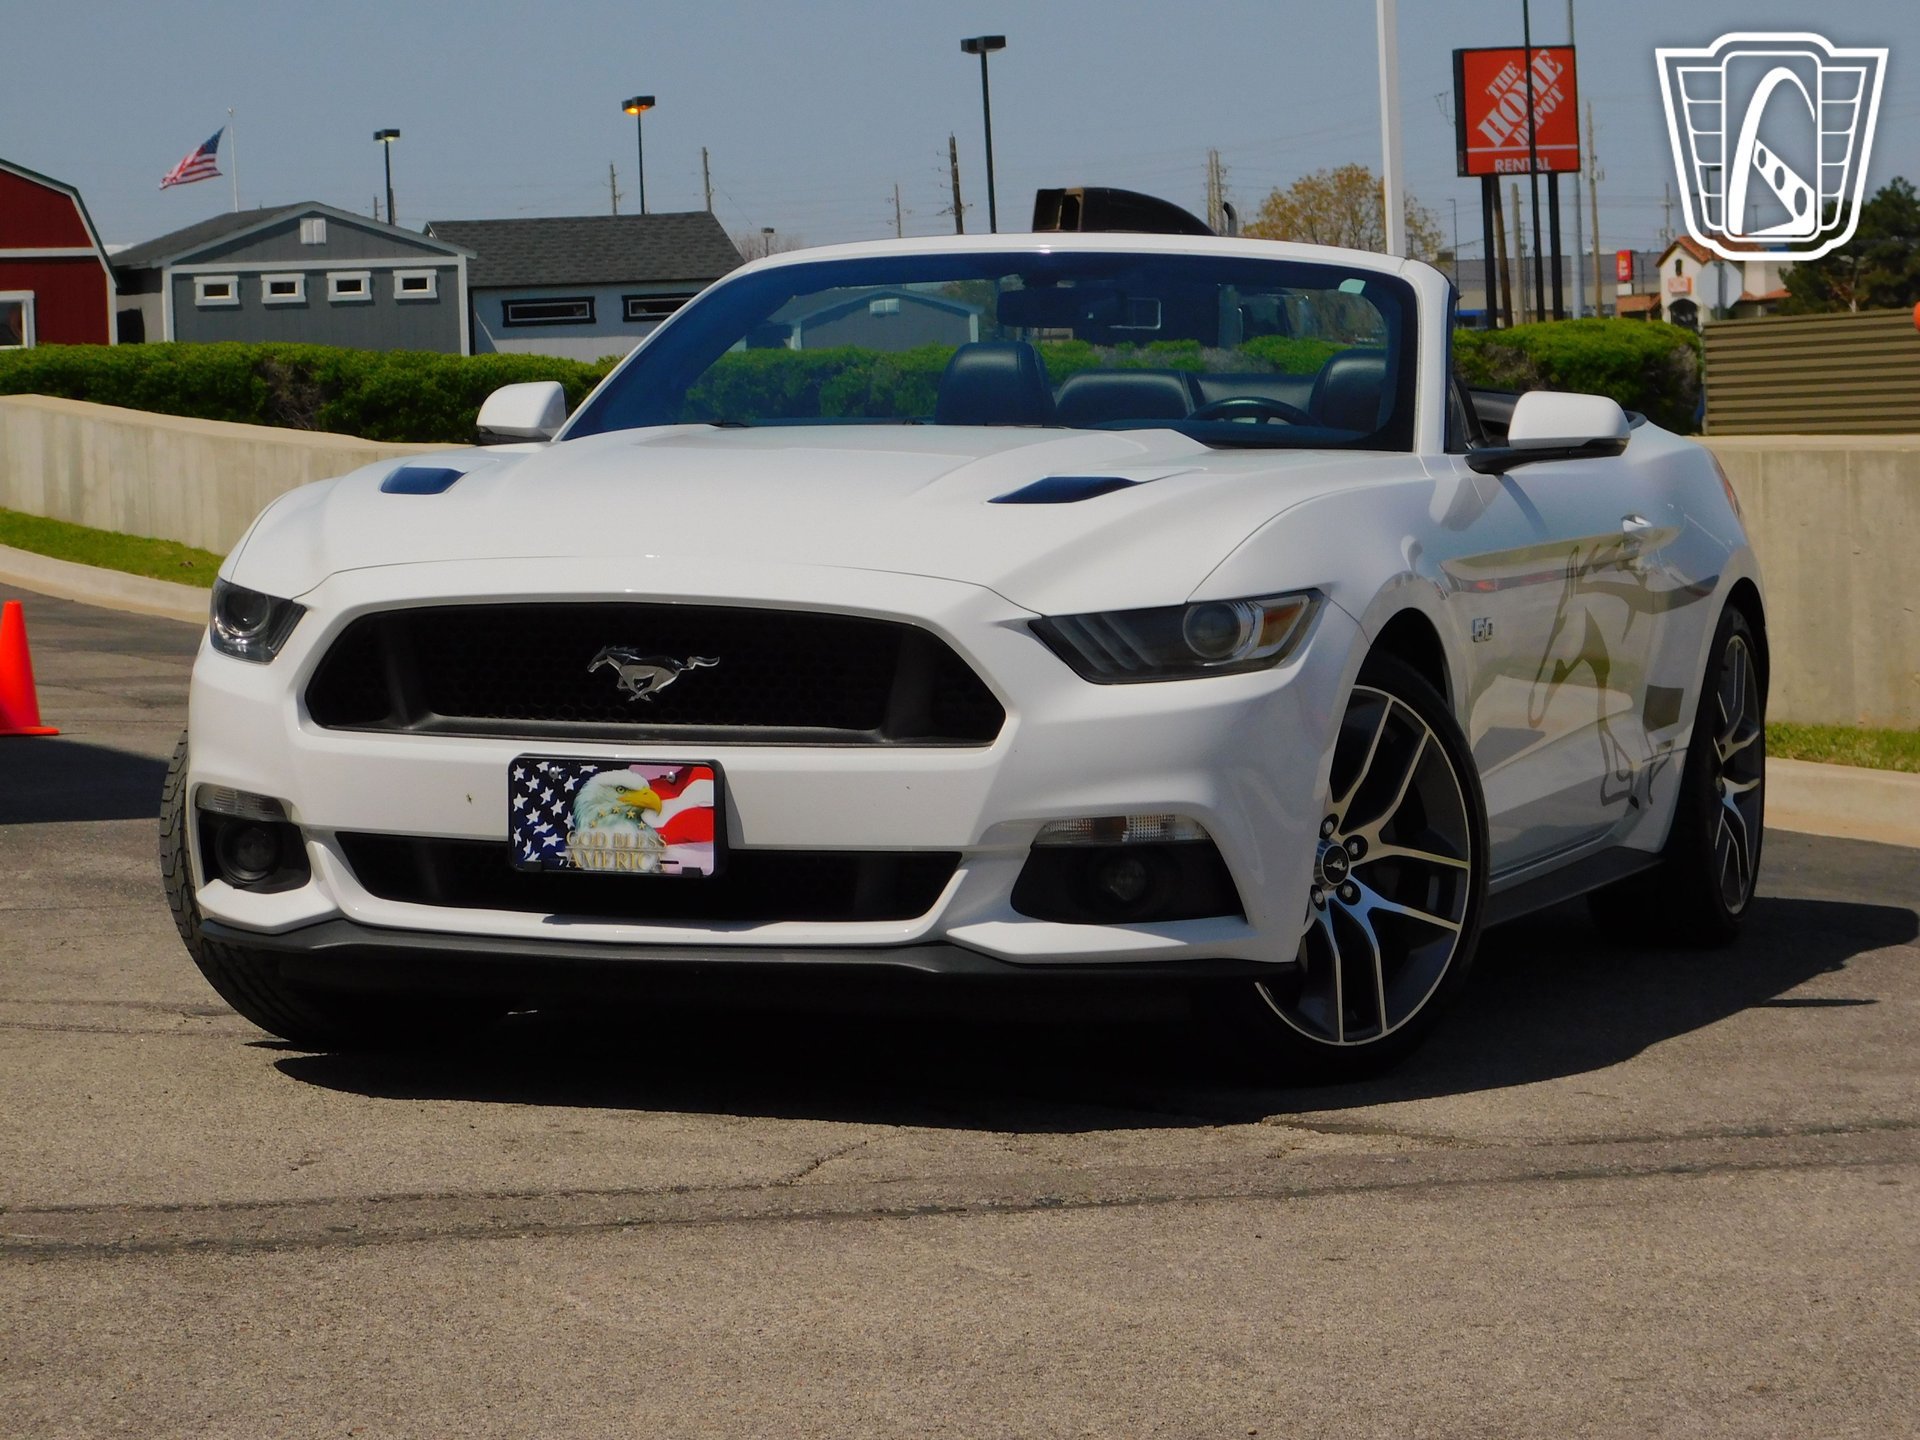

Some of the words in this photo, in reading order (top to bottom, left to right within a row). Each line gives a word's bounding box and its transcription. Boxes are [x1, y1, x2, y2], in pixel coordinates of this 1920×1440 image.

[1485, 61, 1521, 100] THE
[1477, 49, 1563, 147] HOME
[1495, 157, 1552, 173] RENTAL
[566, 830, 608, 848] GOD
[612, 831, 668, 849] BLESS
[565, 848, 667, 872] AMERICA
